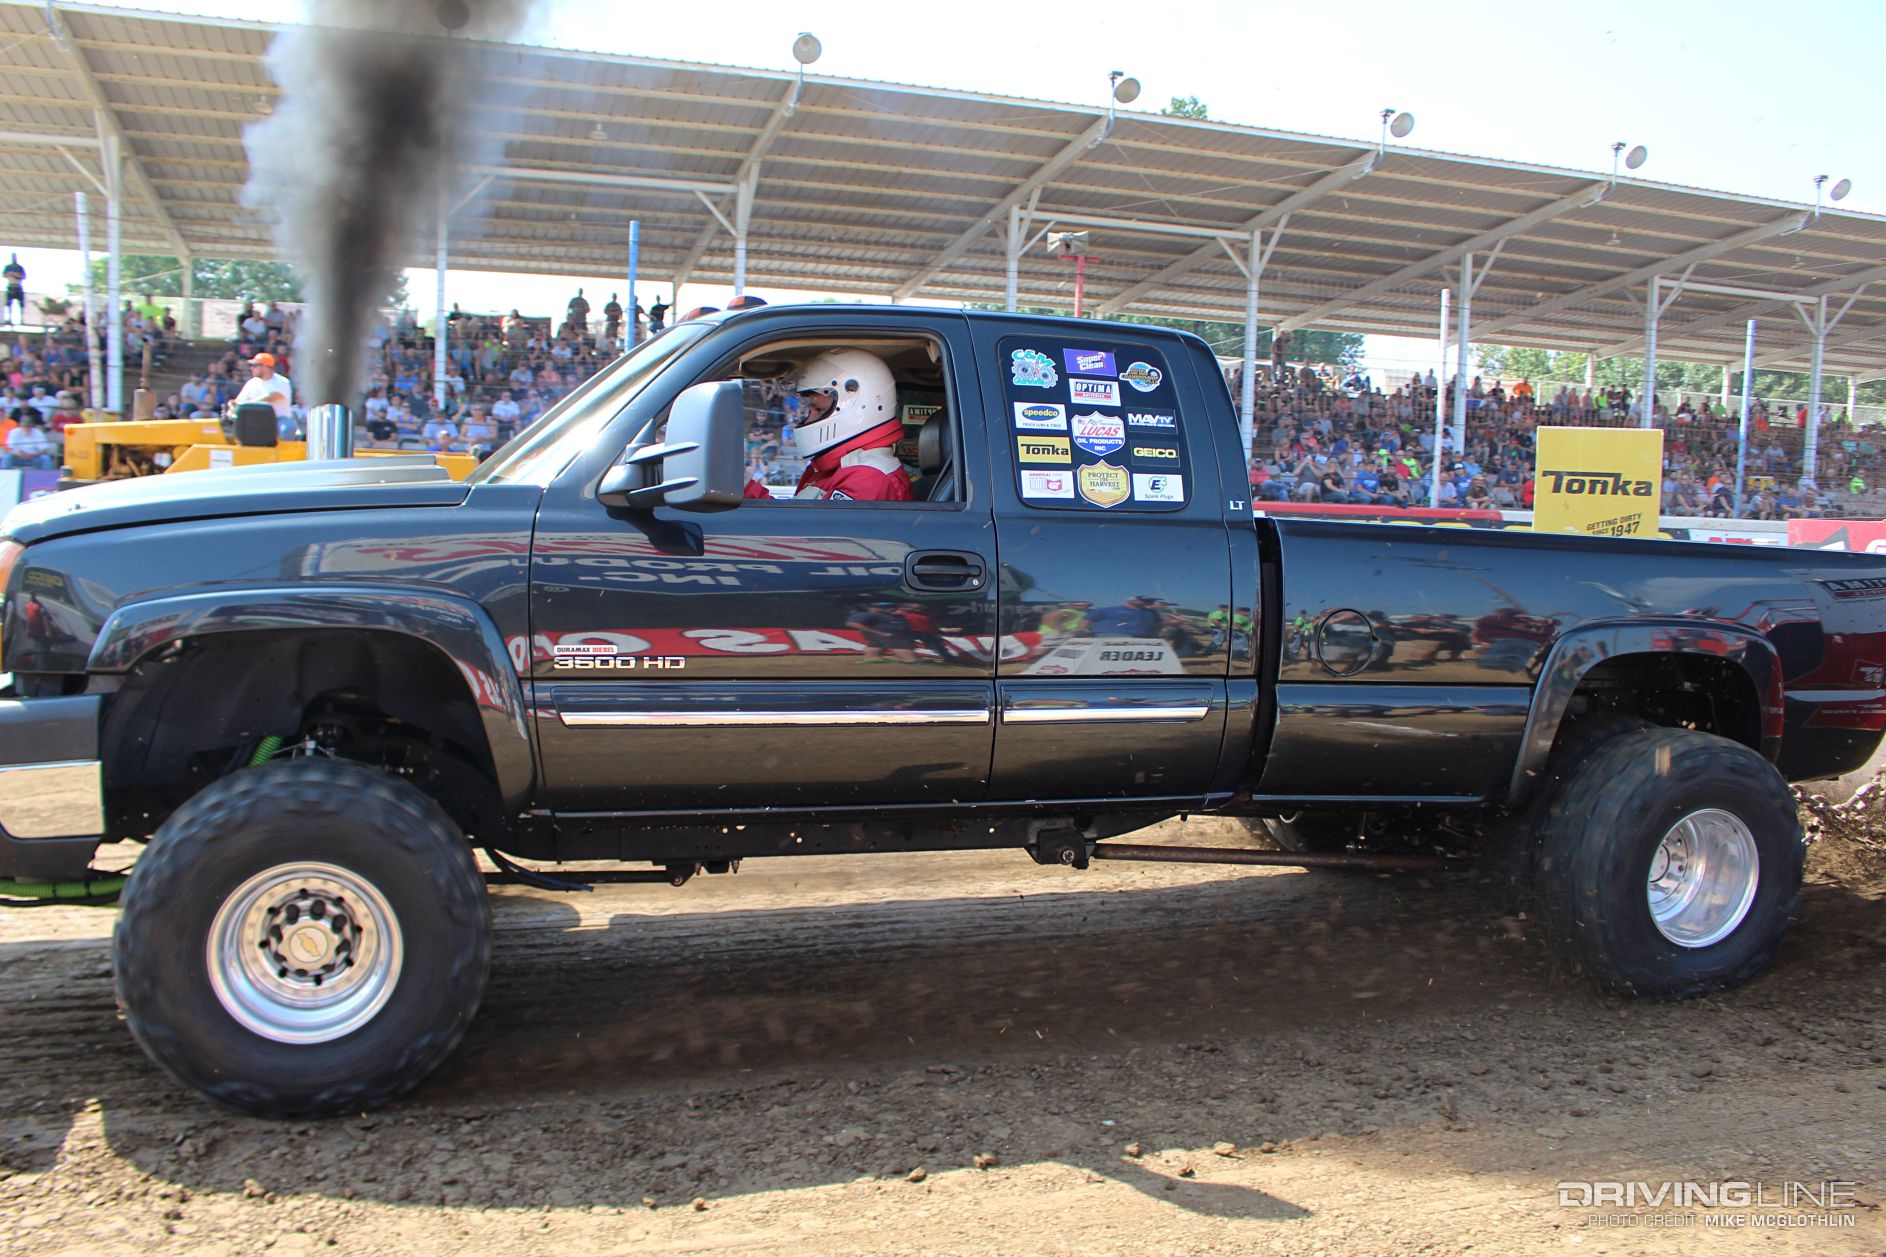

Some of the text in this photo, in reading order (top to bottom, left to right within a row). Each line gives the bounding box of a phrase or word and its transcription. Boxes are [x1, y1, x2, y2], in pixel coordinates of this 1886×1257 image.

[1077, 353, 1103, 364] Super
[1079, 361, 1104, 370] Clean
[1076, 382, 1112, 393] OPTIMA
[1024, 408, 1059, 417] speedco
[1080, 426, 1121, 437] LUCAS
[1021, 444, 1069, 456] Tonka
[1133, 447, 1177, 459] GEICO
[1542, 470, 1653, 497] Tonka
[1230, 500, 1244, 510] LT
[1586, 513, 1642, 531] GETTING DIRTY
[1610, 521, 1640, 537] 1947
[554, 656, 685, 669] 3500 HD
